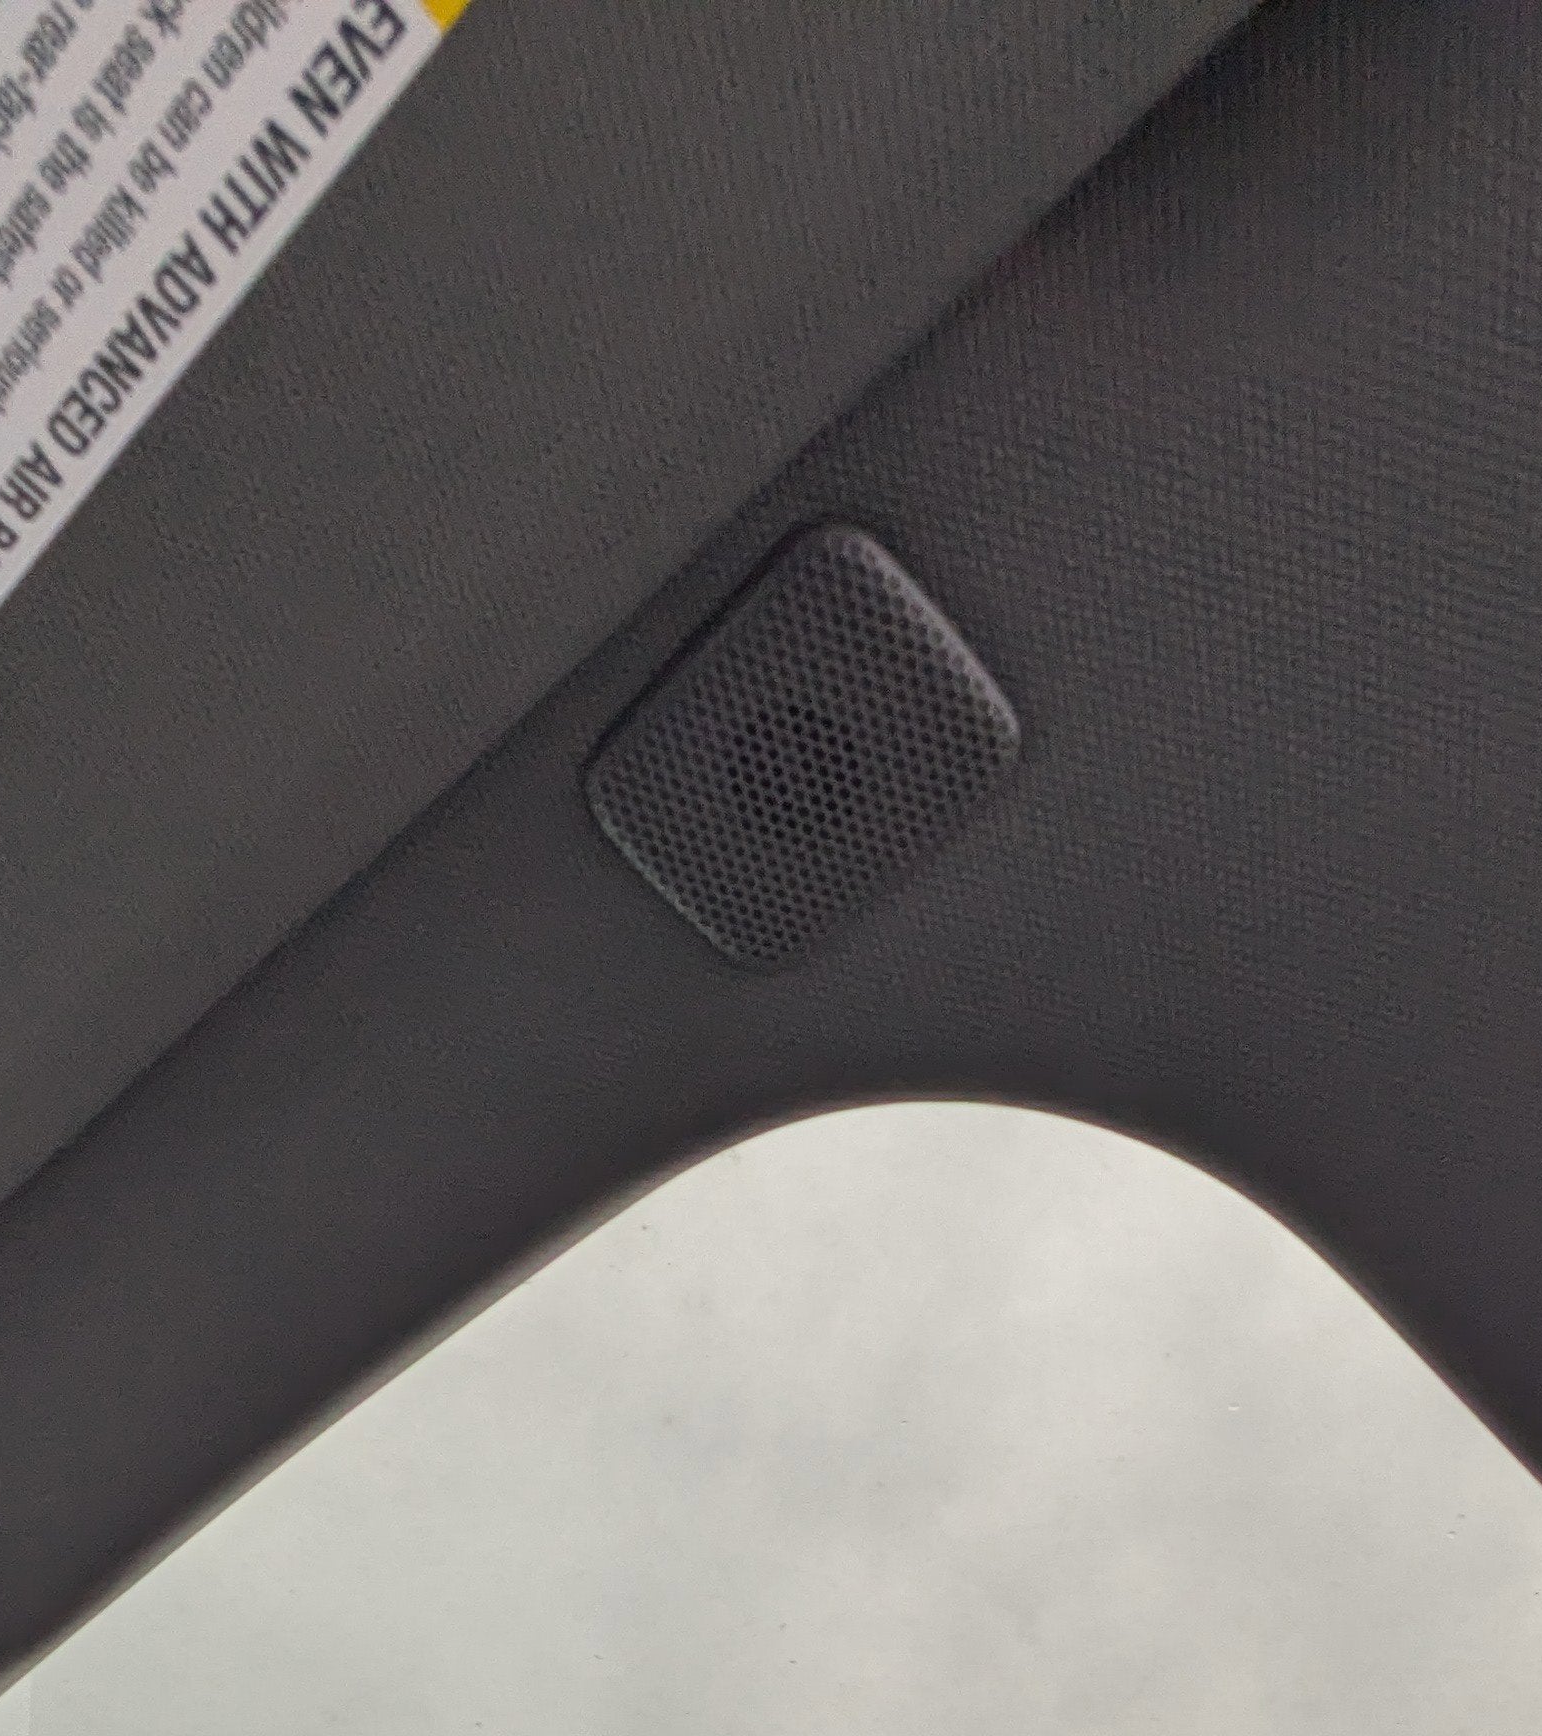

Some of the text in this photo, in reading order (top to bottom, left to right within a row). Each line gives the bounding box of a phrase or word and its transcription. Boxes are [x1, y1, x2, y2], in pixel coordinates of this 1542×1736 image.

[91, 24, 155, 115] seat
[287, 0, 407, 136] EVEN
[70, 96, 115, 141] is
[156, 78, 213, 152] can
[37, 131, 91, 193] the
[127, 143, 177, 193] be
[198, 118, 310, 255] WITH
[69, 186, 147, 283] killed
[49, 265, 84, 310] or
[46, 232, 217, 457] ADVANCED
